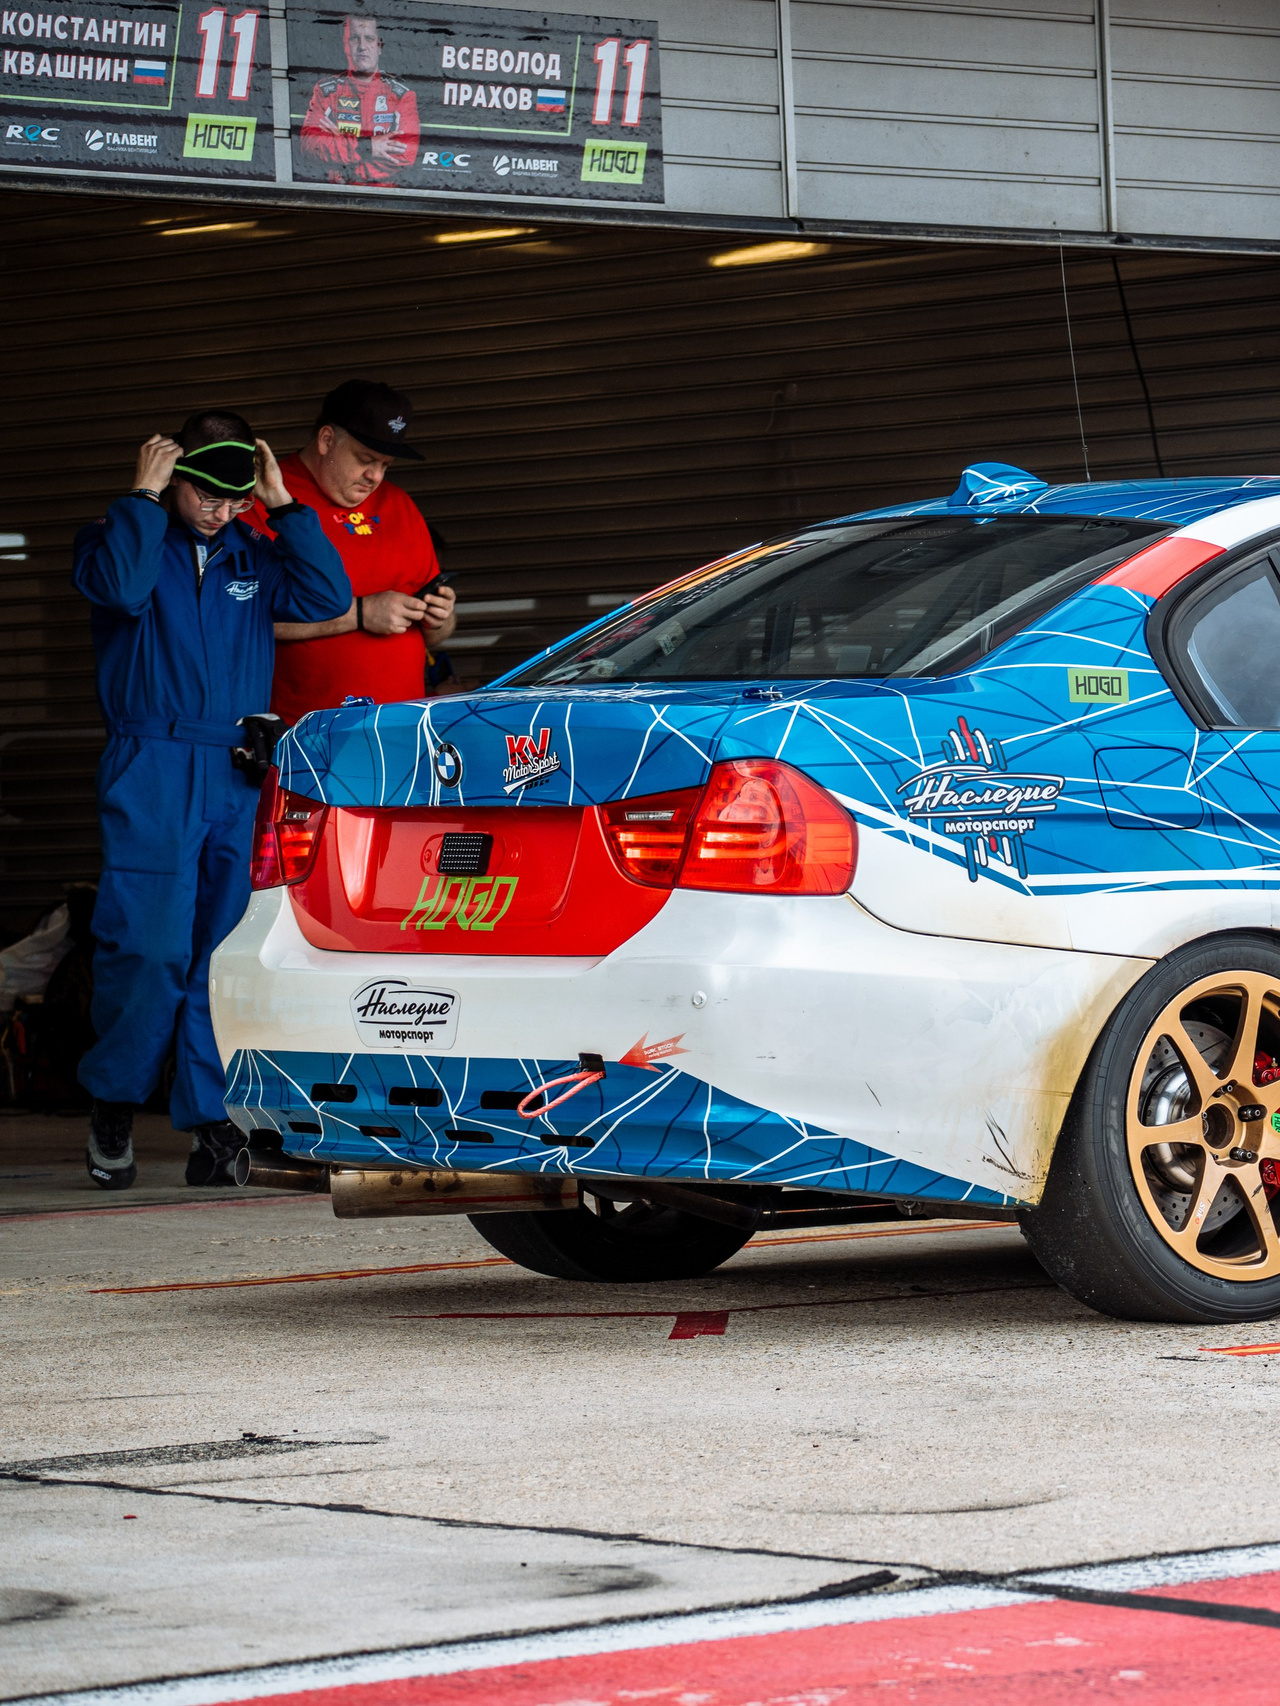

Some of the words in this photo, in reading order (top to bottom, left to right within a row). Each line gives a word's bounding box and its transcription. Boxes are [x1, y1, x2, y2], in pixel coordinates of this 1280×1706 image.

[1, 10, 167, 48] КОНСТАНТИН
[2, 50, 129, 83] КВАШНИН
[195, 6, 260, 101] 11
[441, 45, 562, 80] ВСЕВОЛОД
[443, 82, 533, 111] ПРАХОВ
[592, 37, 650, 127] 11
[106, 132, 158, 147] ГАЛВЕНТ
[193, 123, 248, 151] HOGO
[511, 157, 559, 171] ГАЛВЕНТ
[589, 148, 639, 175] HOGO
[1075, 674, 1123, 697] HOGO
[505, 728, 552, 769] KV
[904, 773, 1060, 815] Наследие
[944, 817, 1036, 835] моторспорт
[400, 876, 519, 931] HOGO
[357, 987, 451, 1027] Наследие
[379, 1029, 434, 1043] моторспорт
